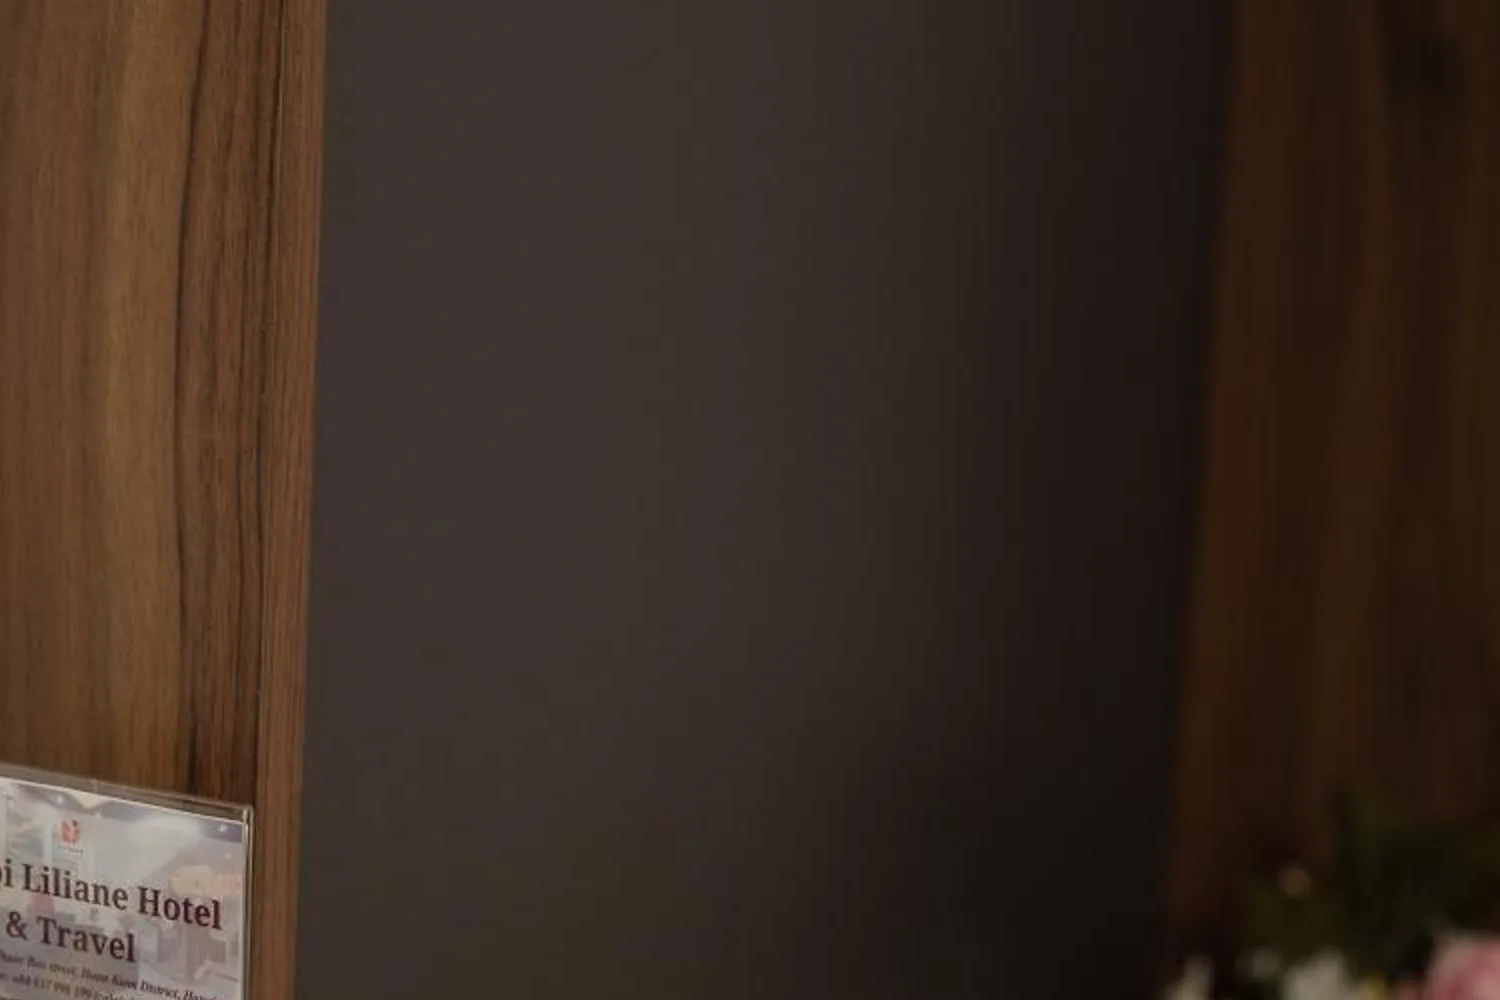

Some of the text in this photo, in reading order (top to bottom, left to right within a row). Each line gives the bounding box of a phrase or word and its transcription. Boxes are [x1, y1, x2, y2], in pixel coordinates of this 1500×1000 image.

[21, 862, 129, 911] Liliane
[136, 885, 223, 930] Hotel
[5, 910, 28, 941] &
[36, 915, 137, 963] Travel
